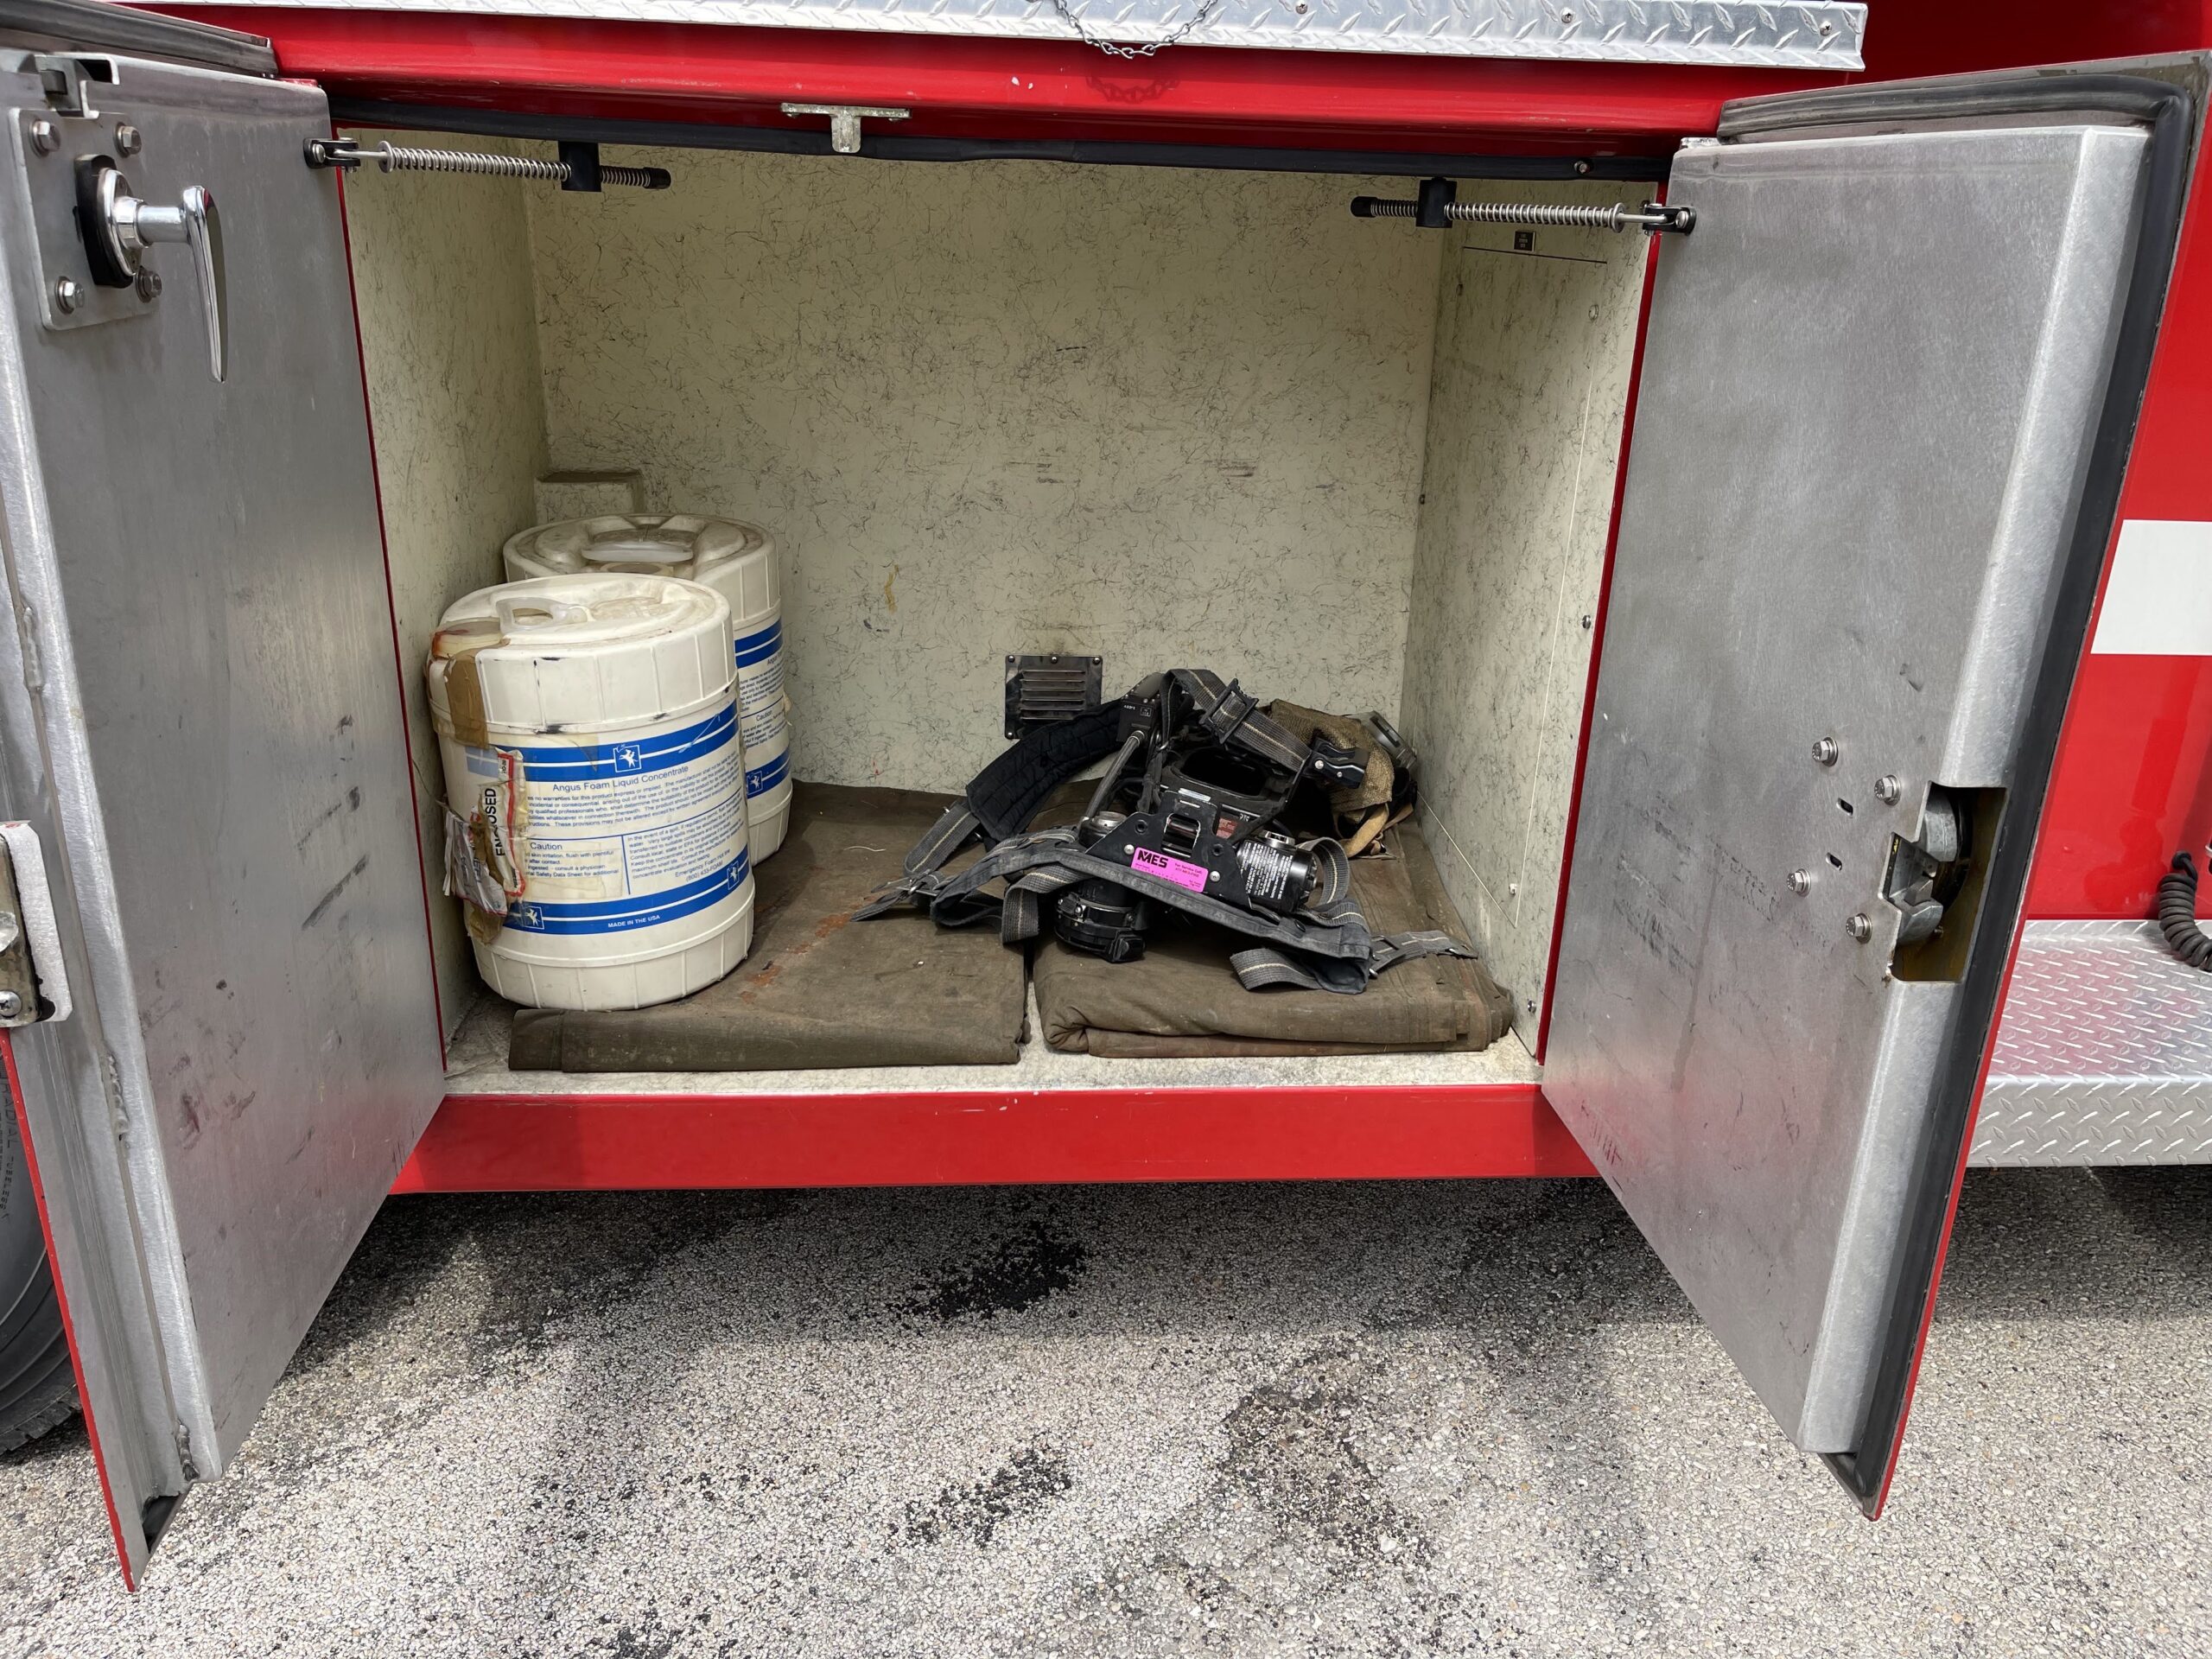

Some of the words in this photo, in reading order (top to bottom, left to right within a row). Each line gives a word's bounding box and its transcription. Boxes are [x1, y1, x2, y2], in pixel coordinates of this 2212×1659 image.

[756, 710, 772, 721] Caution
[553, 784, 582, 792] Angus
[613, 776, 639, 787] Liquid
[641, 766, 689, 783] Concentrate
[676, 772, 702, 784] manufacturer
[696, 781, 710, 791] product
[691, 794, 711, 804] agreement
[685, 817, 706, 827] regulations
[683, 831, 704, 841] containers
[701, 830, 717, 841] guidance
[682, 852, 698, 861] Consult
[705, 838, 726, 852] manufacturer
[656, 852, 683, 861] concentrate
[1137, 849, 1168, 868] MES
[632, 869, 663, 879] concentrate
[664, 863, 688, 873] evaluation
[676, 864, 703, 877] Emergency
[704, 857, 717, 866] Foam
[686, 871, 701, 882] (800)
[701, 861, 724, 874] 433-FOAM
